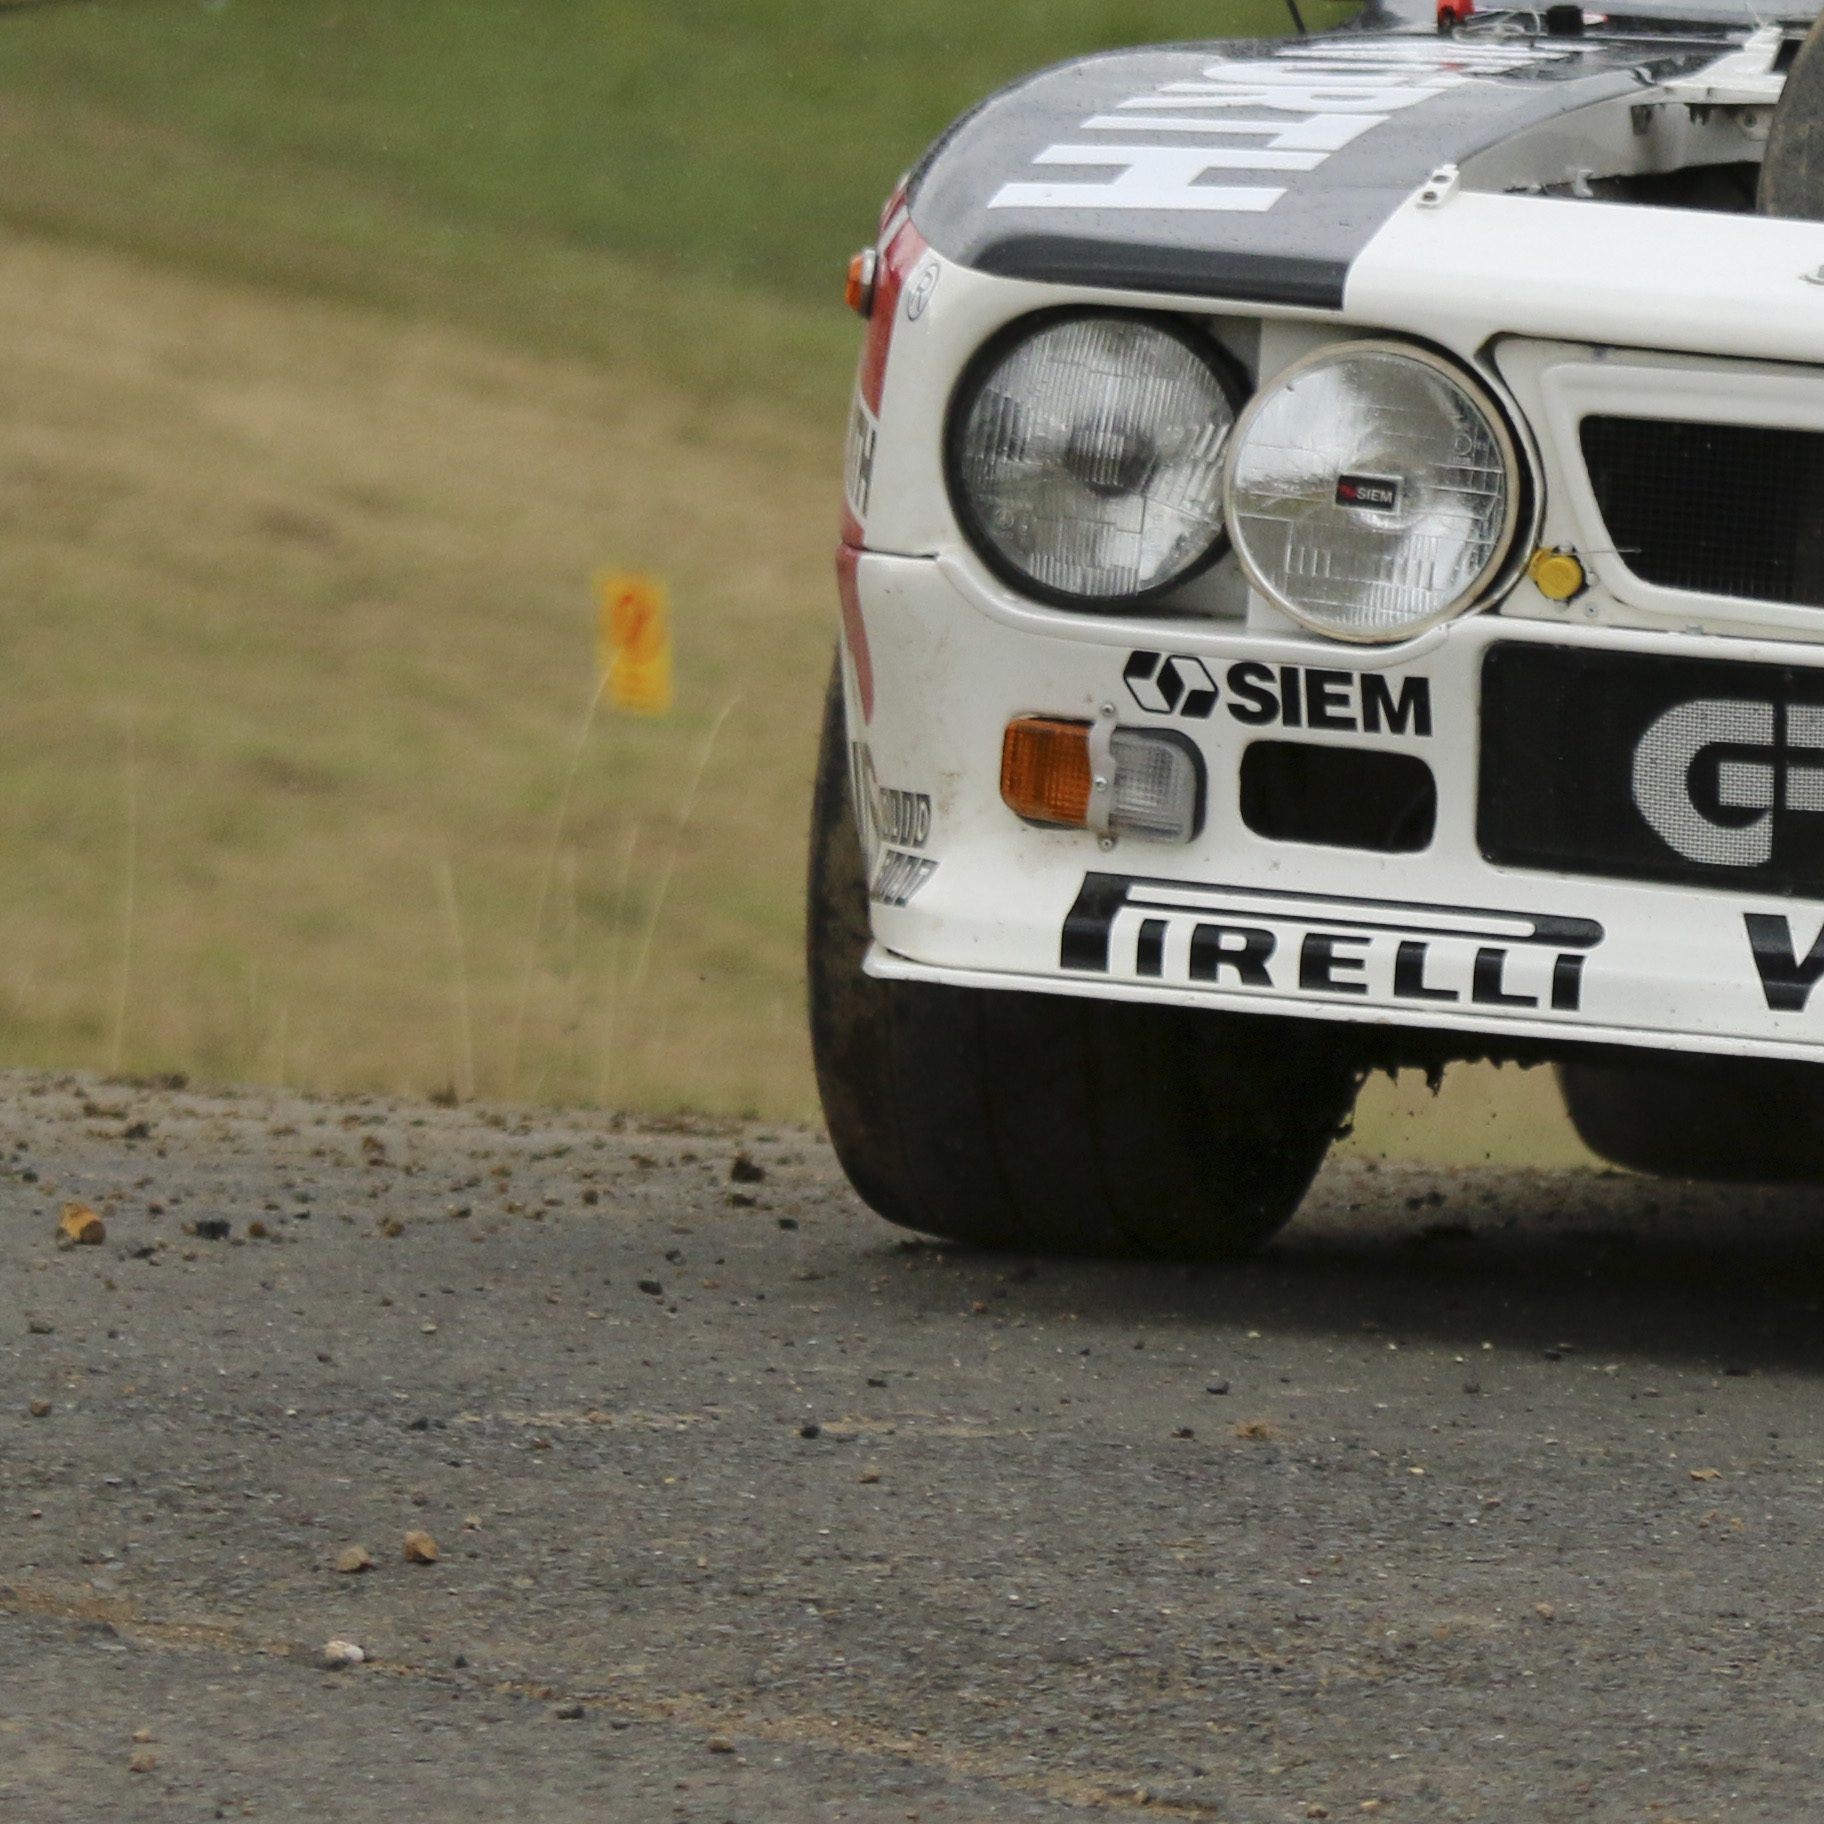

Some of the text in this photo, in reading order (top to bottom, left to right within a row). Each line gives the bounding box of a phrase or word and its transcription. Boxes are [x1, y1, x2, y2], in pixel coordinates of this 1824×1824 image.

[1356, 487, 1393, 503] SIEM
[1227, 662, 1433, 737] SIEM
[1060, 872, 1605, 1011] PIRELLI
